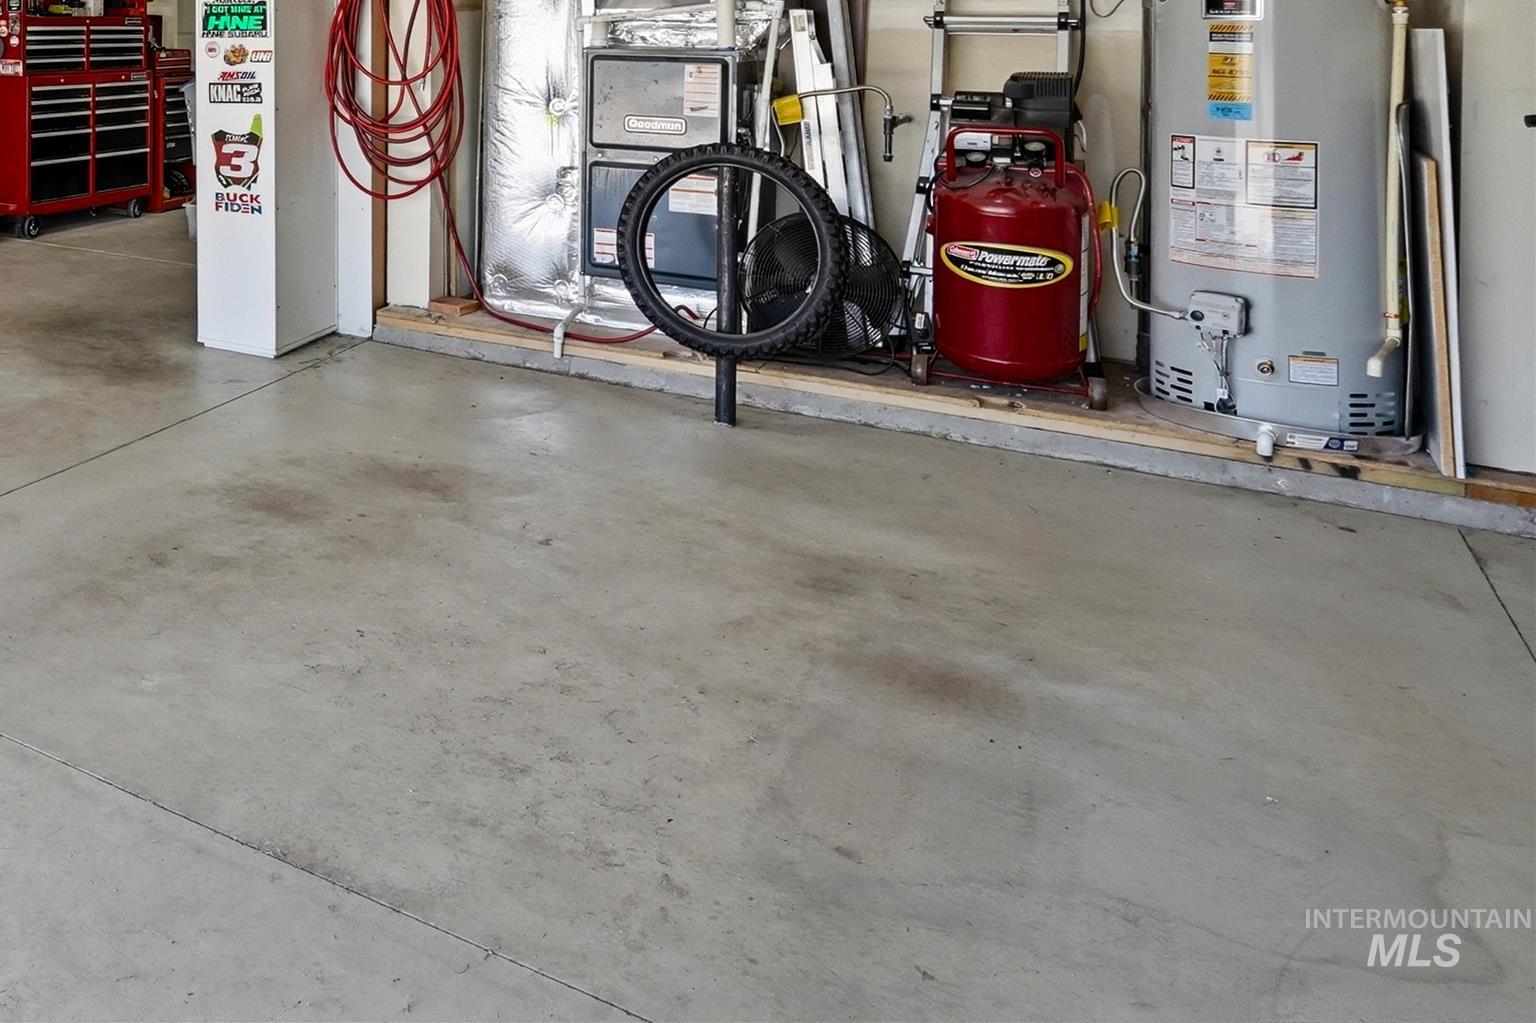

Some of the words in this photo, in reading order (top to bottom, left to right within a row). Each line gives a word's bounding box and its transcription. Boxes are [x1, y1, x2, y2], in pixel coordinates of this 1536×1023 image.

[211, 5, 230, 14] GOT
[207, 15, 264, 30] HINE
[218, 71, 257, 81] AMSOIL
[209, 84, 241, 102] KNAC
[628, 119, 682, 131] Goodman
[219, 142, 259, 178] 3
[215, 192, 261, 205] BUCK
[215, 201, 262, 215] FIDEN
